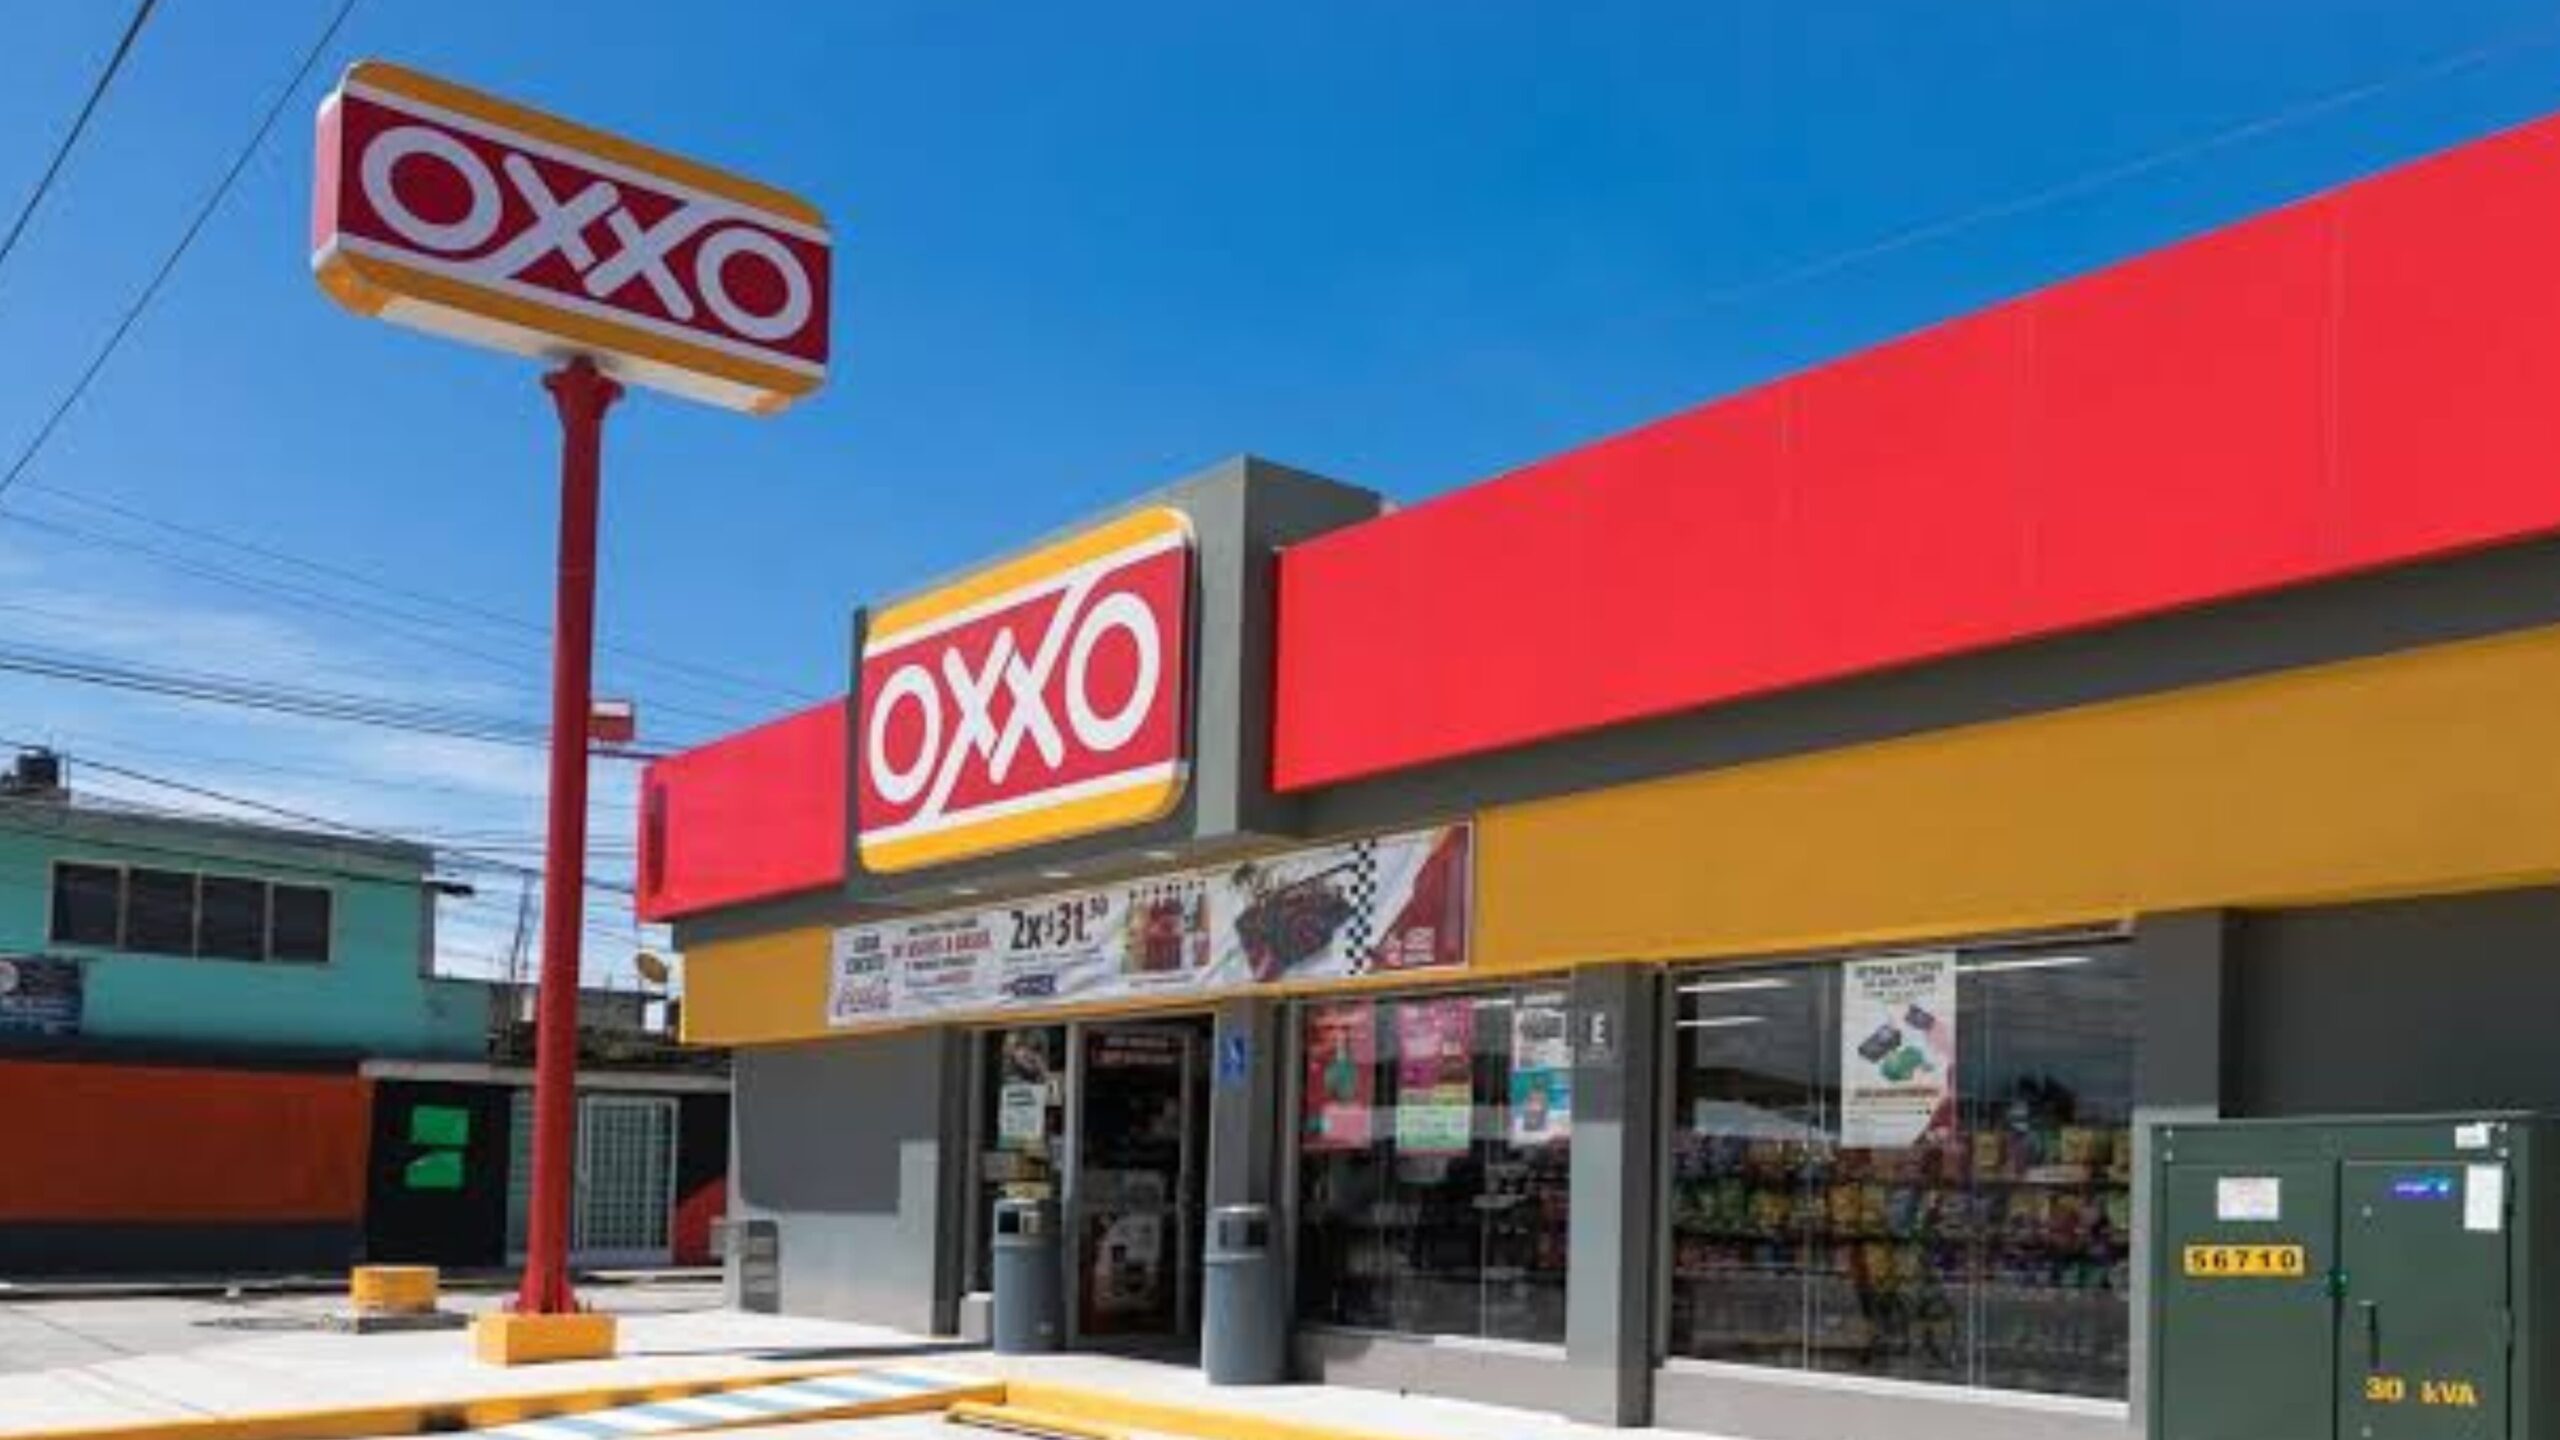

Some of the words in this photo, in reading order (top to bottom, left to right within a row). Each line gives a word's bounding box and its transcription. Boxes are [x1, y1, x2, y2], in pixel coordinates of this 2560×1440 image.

[362, 126, 812, 340] OXXO
[869, 588, 1161, 812] OXXO
[2193, 1249, 2296, 1270] 56710
[2365, 1377, 2406, 1401] 30
